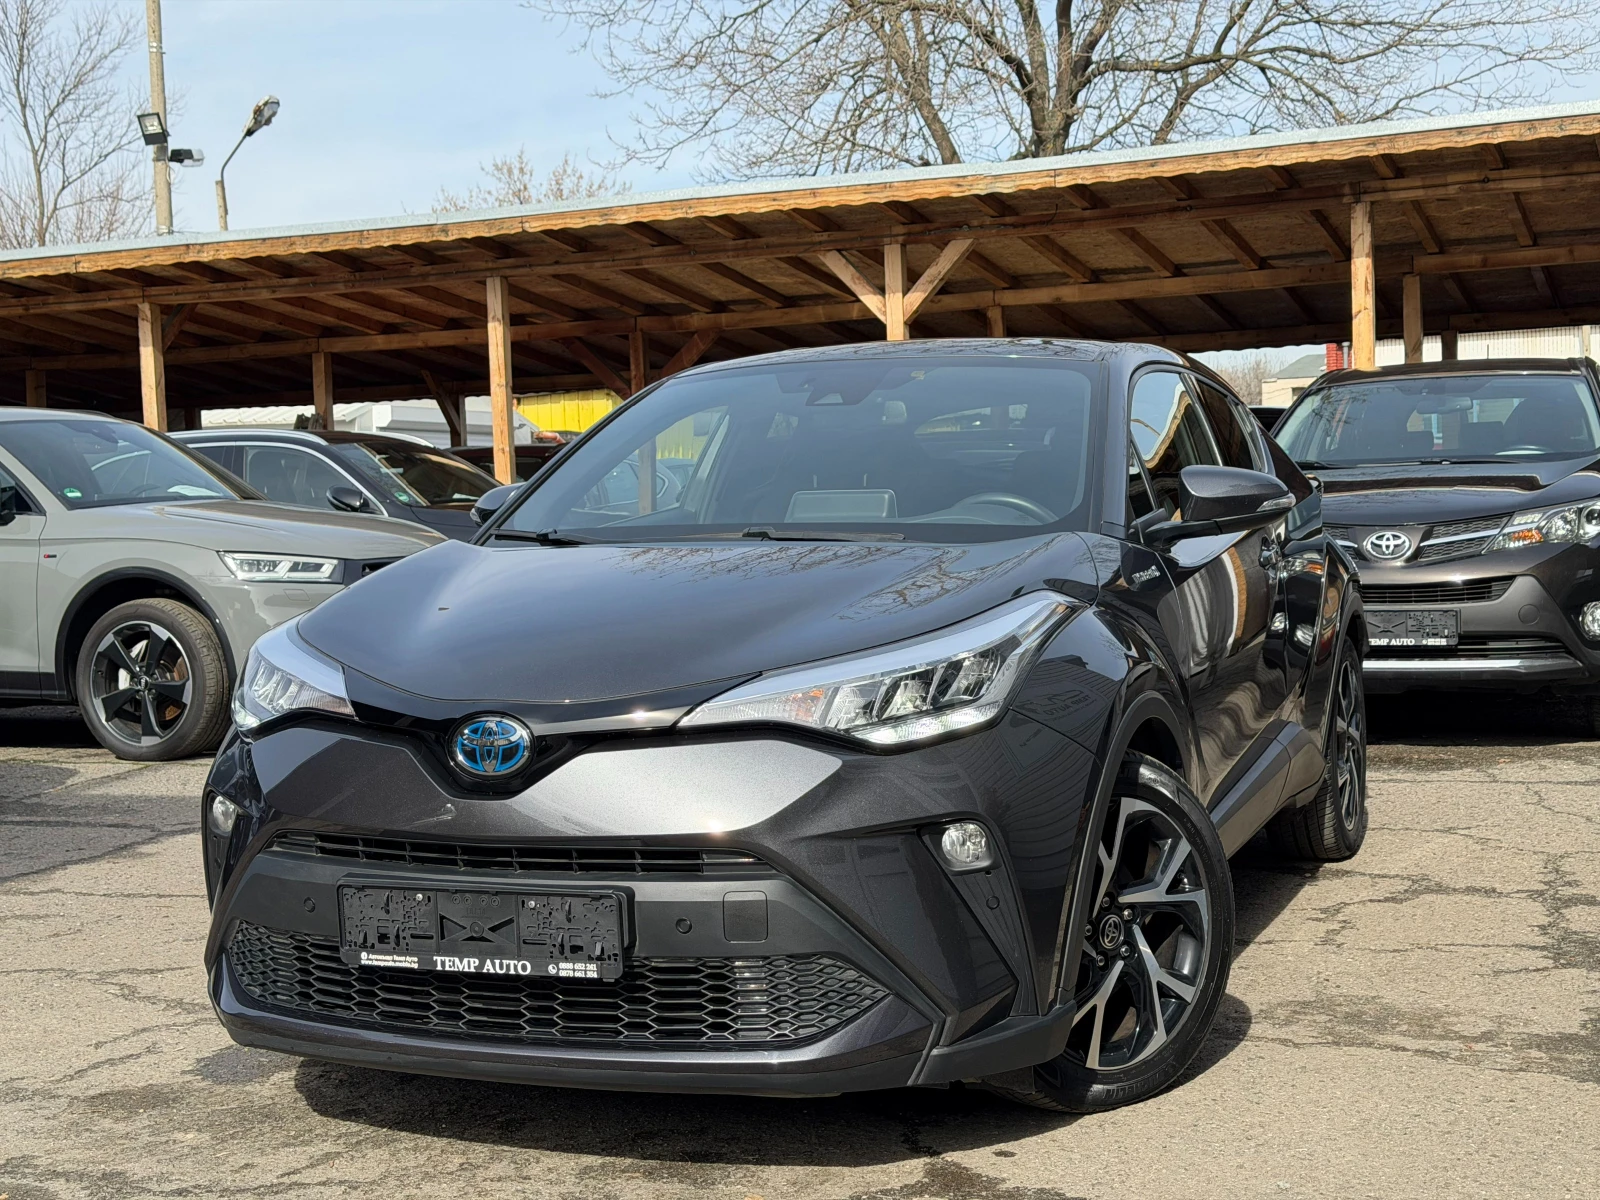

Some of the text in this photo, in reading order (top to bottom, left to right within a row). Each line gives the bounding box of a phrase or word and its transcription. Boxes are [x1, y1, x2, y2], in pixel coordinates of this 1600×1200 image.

[1390, 638, 1415, 646] AUTO
[433, 956, 532, 975] TEMP AUTO
